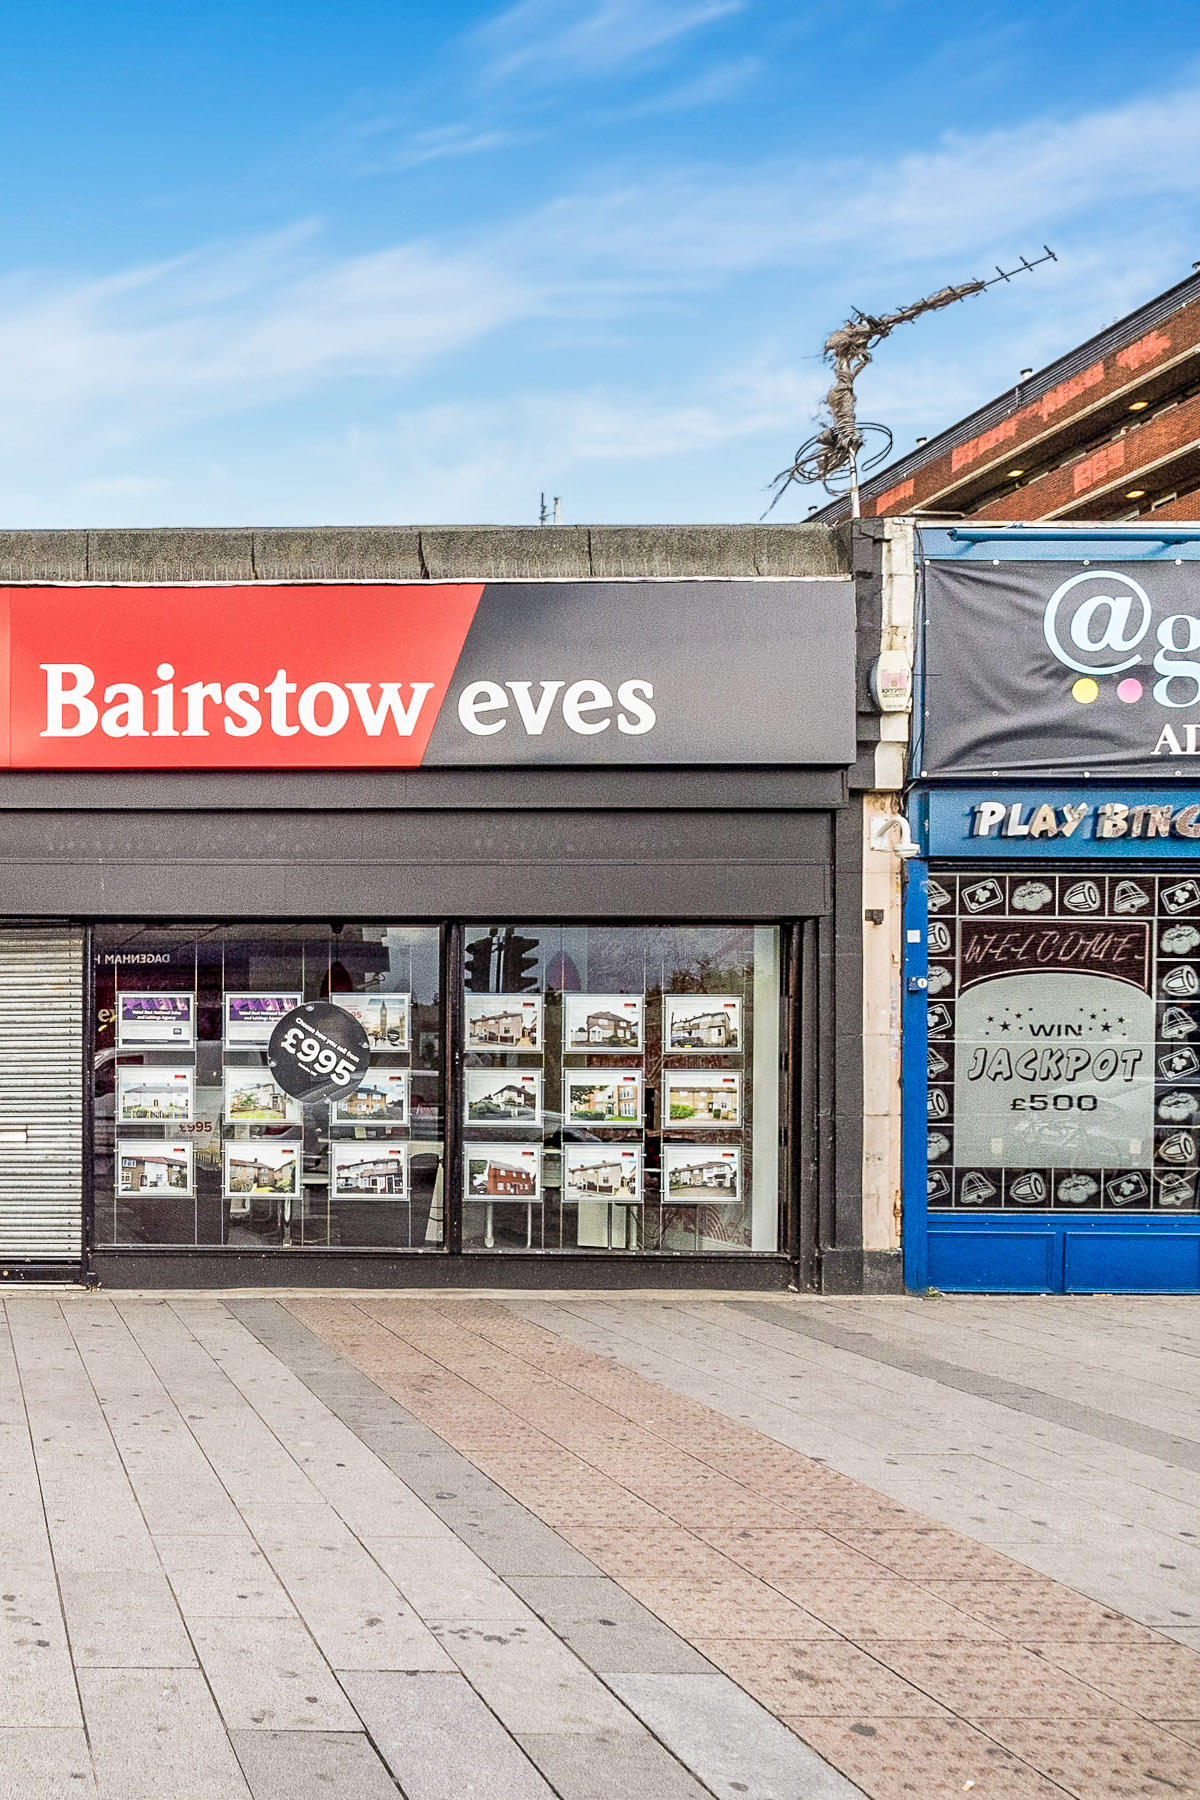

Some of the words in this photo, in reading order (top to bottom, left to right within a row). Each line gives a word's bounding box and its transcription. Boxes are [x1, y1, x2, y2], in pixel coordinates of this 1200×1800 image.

[39, 662, 435, 738] Bairstow
[457, 679, 657, 736] eves
[974, 801, 1088, 838] PLAY
[964, 931, 1142, 963] WELCOME
[281, 1028, 356, 1086] £995
[326, 1039, 337, 1049] you
[968, 1048, 1143, 1082] JACKPOT
[1010, 1094, 1098, 1111] £500
